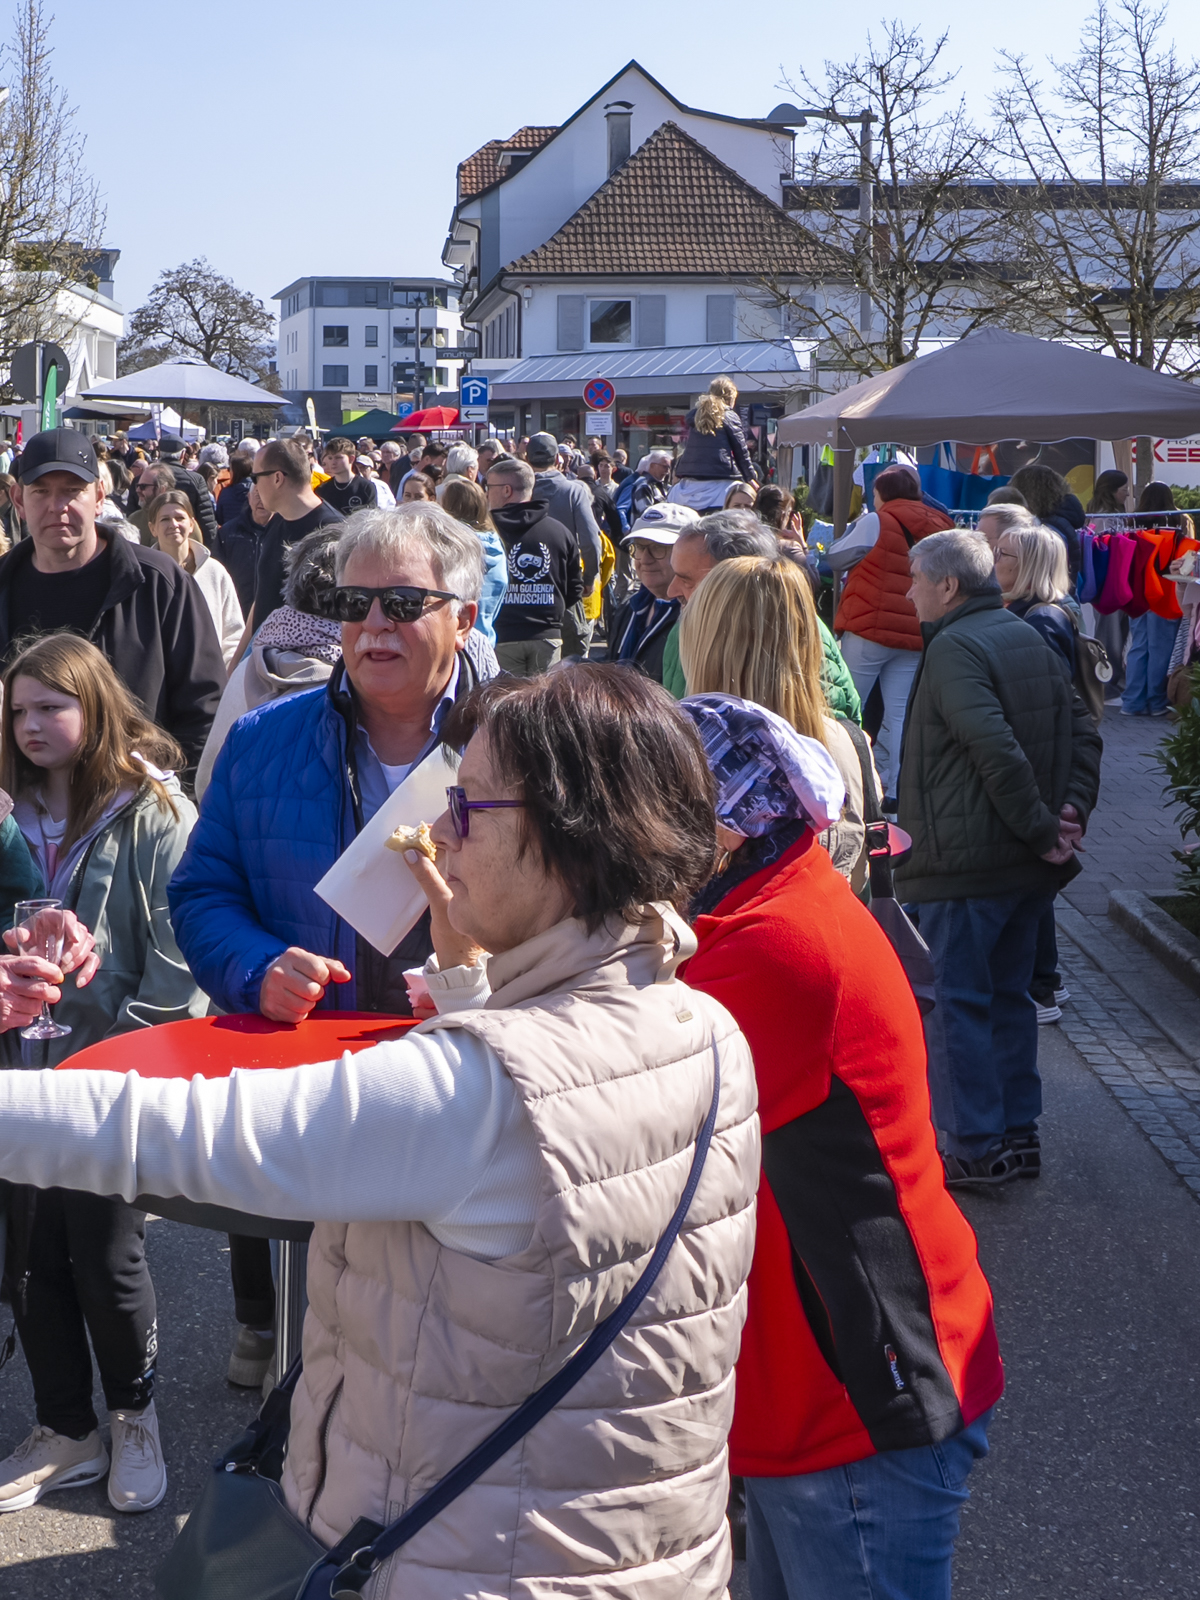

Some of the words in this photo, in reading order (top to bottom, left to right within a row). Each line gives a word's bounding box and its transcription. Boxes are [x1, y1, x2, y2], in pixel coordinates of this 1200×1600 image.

[469, 387, 481, 403] P
[505, 584, 518, 592] UM
[520, 584, 554, 593] GOLDENEN
[502, 593, 554, 604] HANDSCHUH
